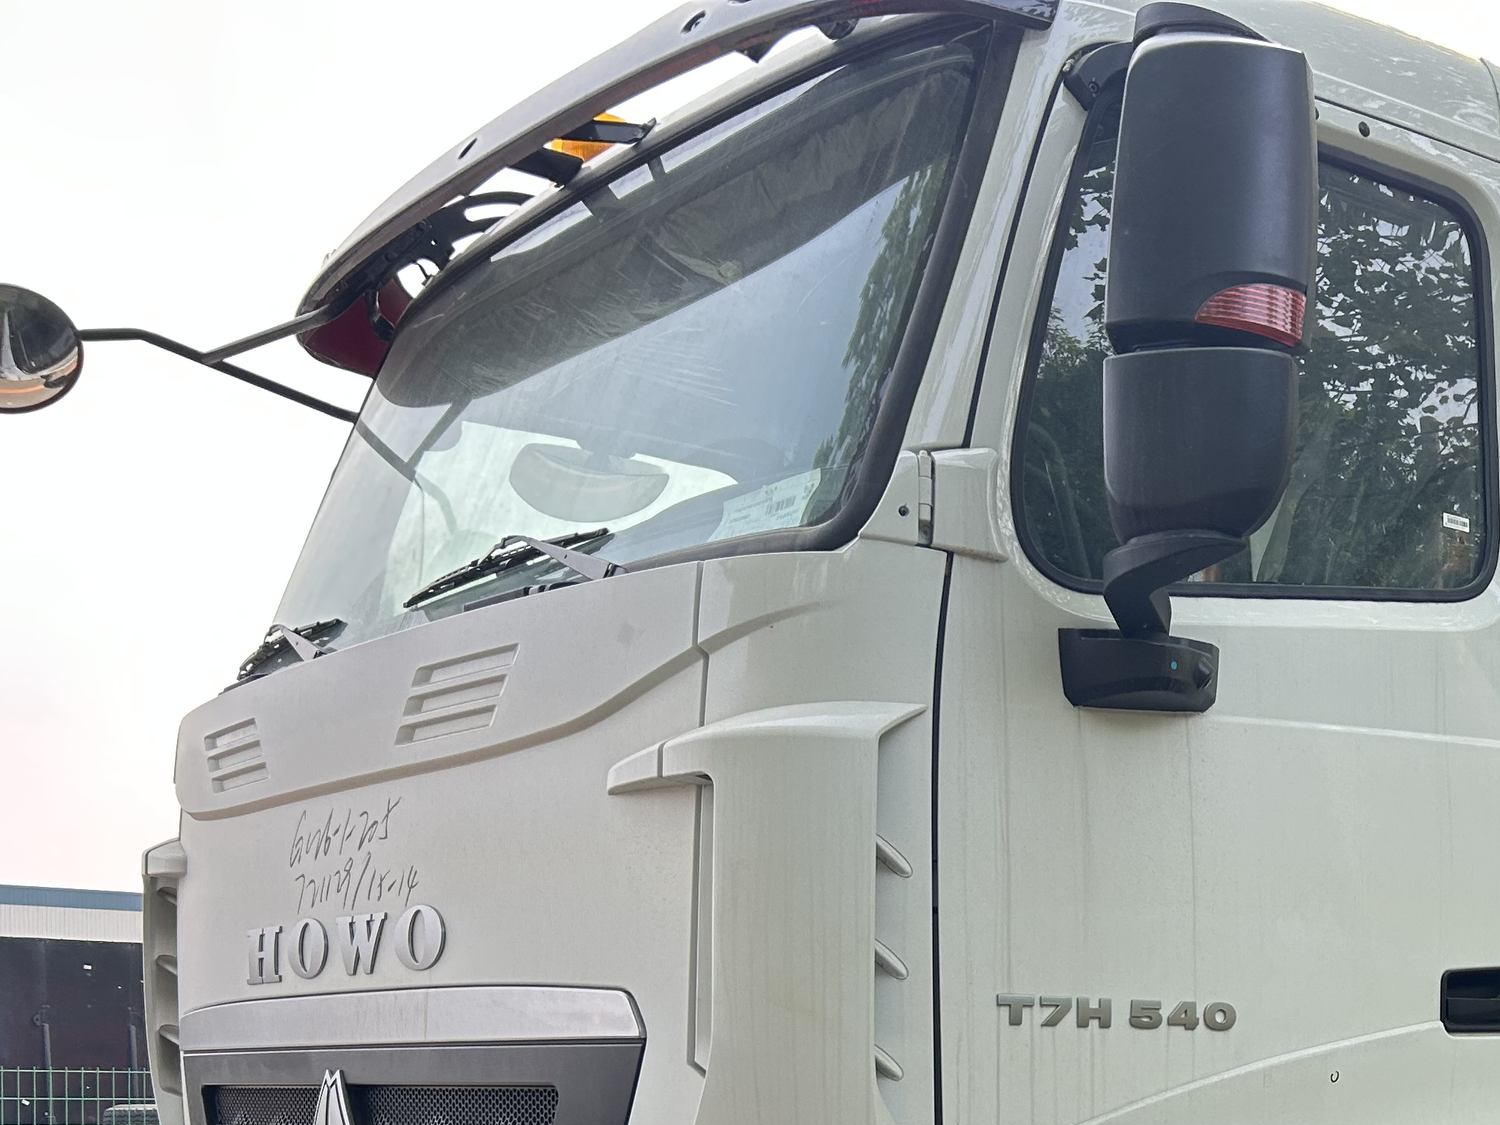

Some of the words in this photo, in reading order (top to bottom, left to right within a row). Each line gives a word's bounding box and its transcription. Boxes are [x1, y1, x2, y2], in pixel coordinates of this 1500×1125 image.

[246, 904, 446, 985] HOWO
[996, 994, 1112, 1029] T7H
[1129, 1000, 1237, 1031] 540
